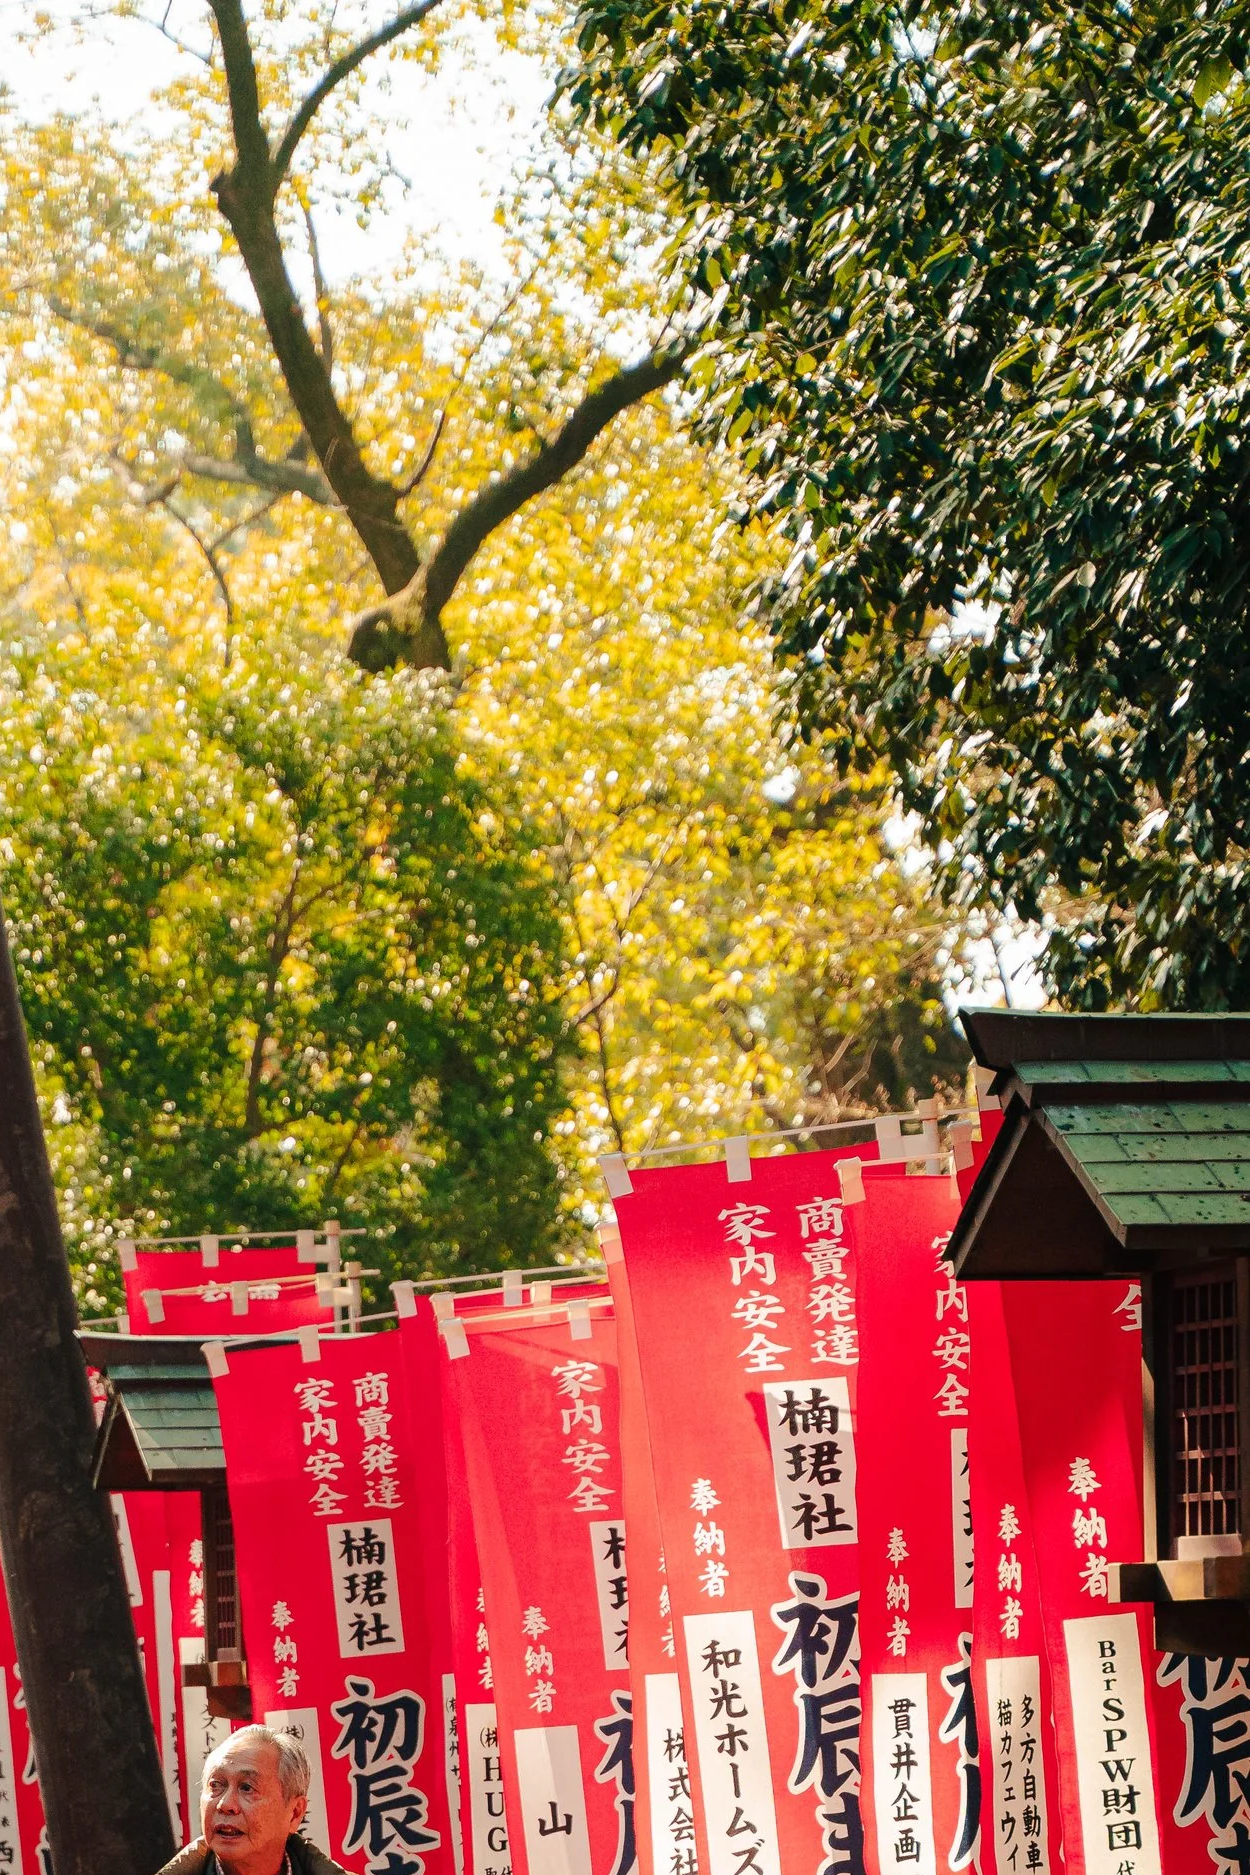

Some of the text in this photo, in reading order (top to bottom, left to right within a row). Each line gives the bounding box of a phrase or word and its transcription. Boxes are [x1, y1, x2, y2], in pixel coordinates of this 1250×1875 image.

[717, 1202, 793, 1375] 家内安全
[793, 1196, 860, 1367] 商賣発達
[931, 1230, 970, 1418] 家内安全
[293, 1377, 348, 1516] 家内安全
[352, 1372, 404, 1509] 商賣発達
[550, 1359, 616, 1513] 家内安全
[778, 1387, 854, 1541] 楠珺社
[338, 1526, 397, 1652] 楠珺社
[688, 1477, 727, 1599] 奉納者
[886, 1527, 911, 1657] 奉納者
[997, 1503, 1024, 1640] 奉納者
[1066, 1456, 1110, 1599] 奉納者
[271, 1600, 300, 1697] 奉納者
[521, 1605, 557, 1714] 奉納者
[887, 1698, 921, 1863] 貫井企画
